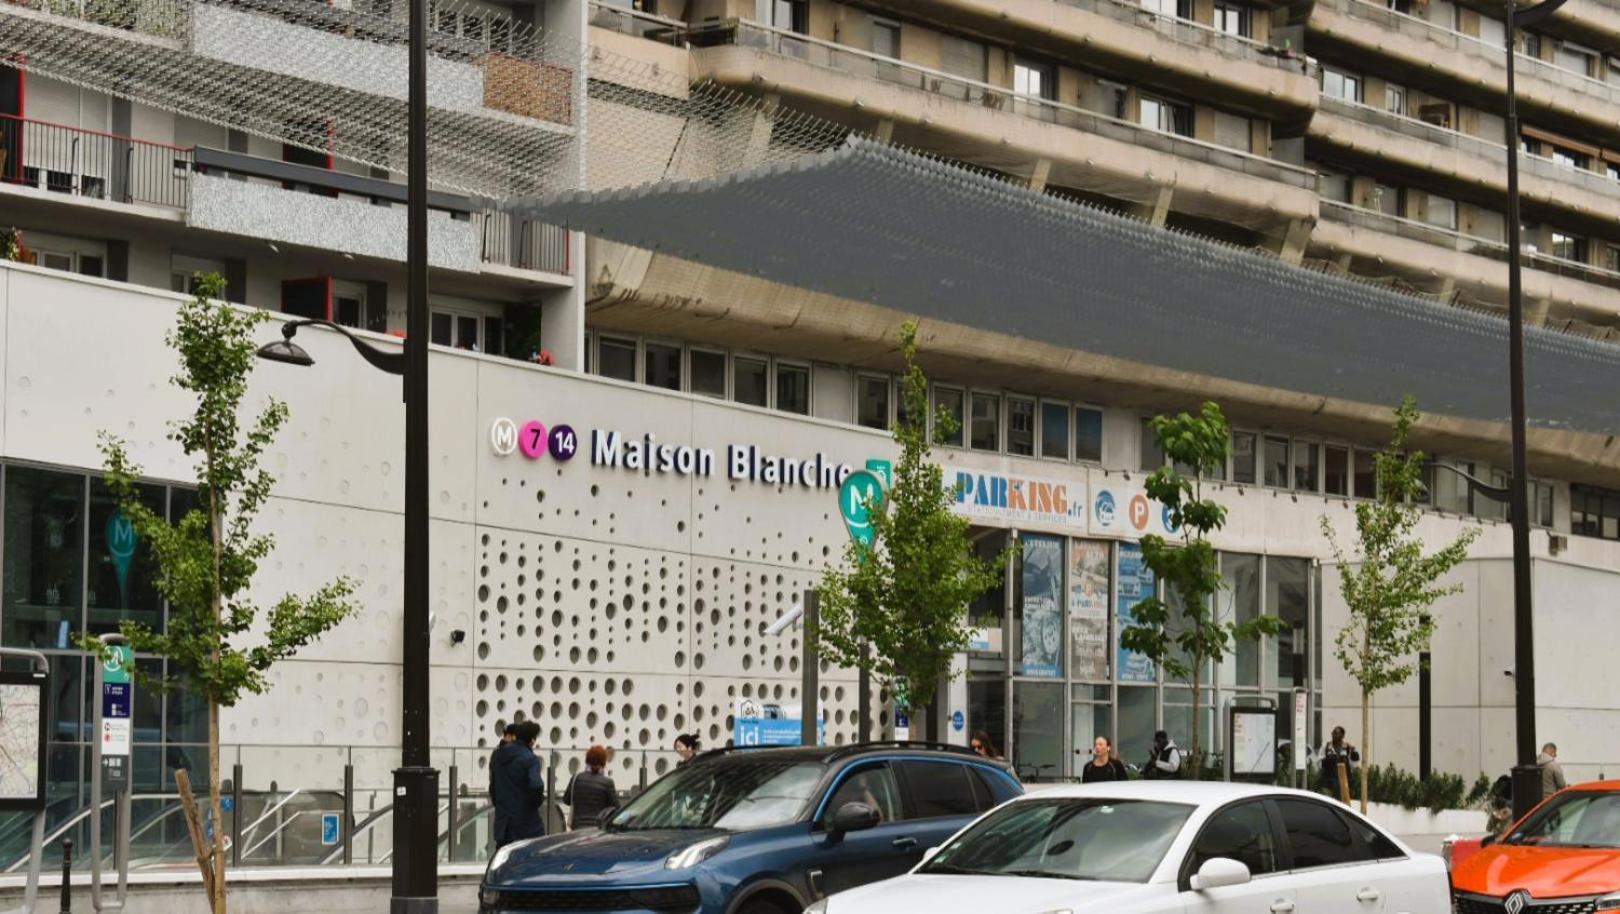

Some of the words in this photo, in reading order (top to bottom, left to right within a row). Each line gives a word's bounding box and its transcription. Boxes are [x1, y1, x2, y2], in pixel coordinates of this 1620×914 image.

[530, 428, 541, 449] 7
[555, 431, 575, 454] 14
[591, 429, 715, 478] Maison
[728, 444, 853, 489] Blanche
[850, 483, 874, 515] M
[1134, 502, 1145, 525] P
